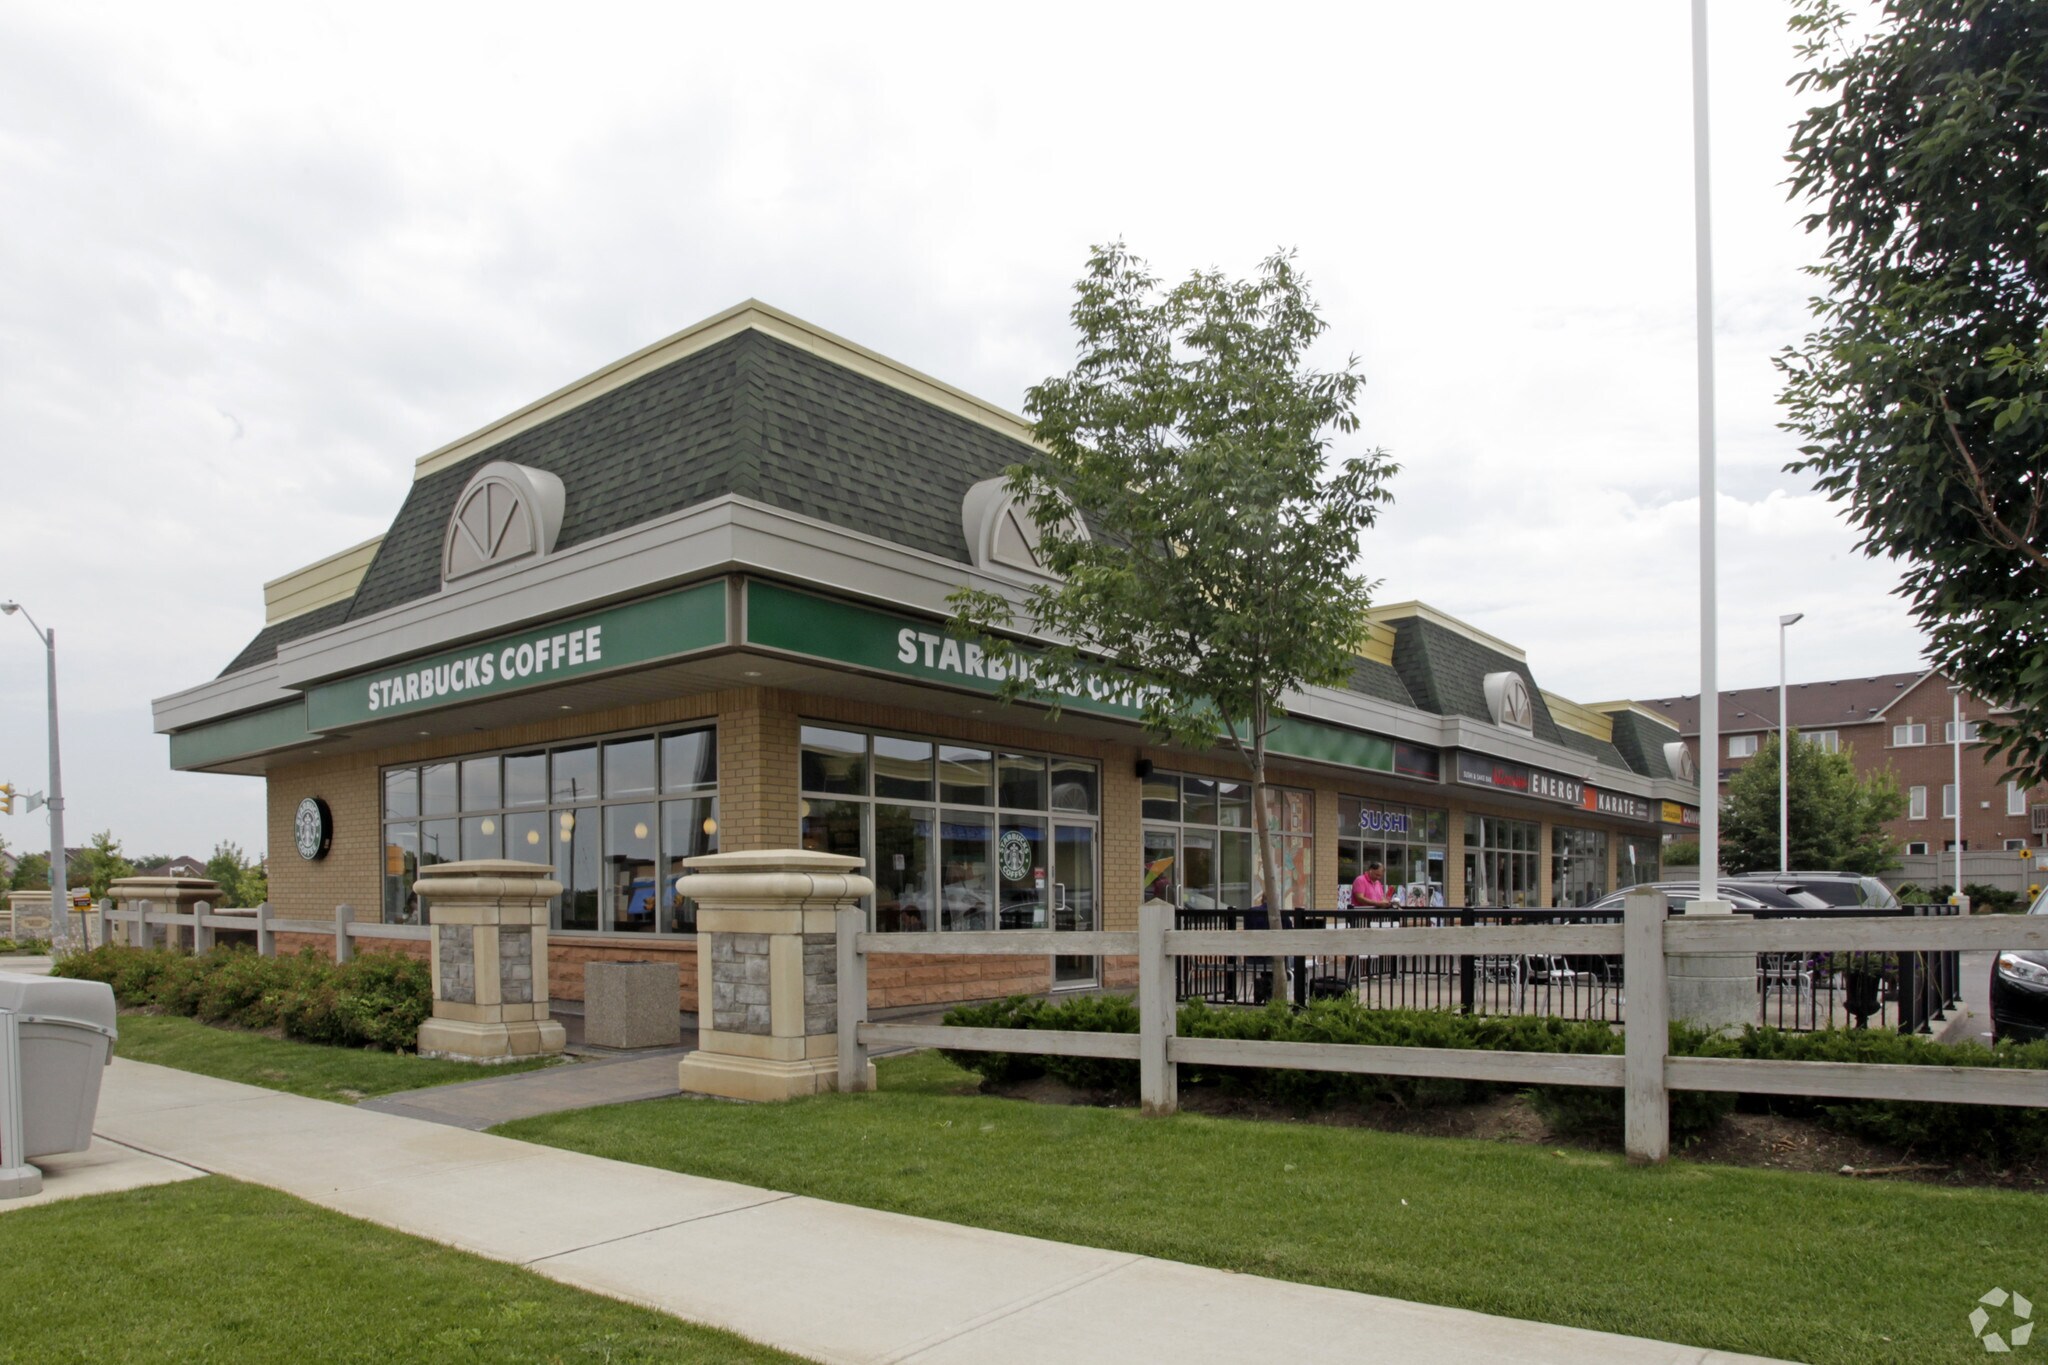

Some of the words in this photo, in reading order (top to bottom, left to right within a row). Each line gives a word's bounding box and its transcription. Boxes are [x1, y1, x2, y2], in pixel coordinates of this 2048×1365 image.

[368, 652, 495, 711] STARBUCKS
[499, 625, 602, 681] COFFEE
[1532, 774, 1581, 802] ENERGY
[1598, 793, 1635, 816] KARATE
[1359, 808, 1408, 833] SUSHI
[1000, 833, 1029, 854] STARBUCKS
[1002, 865, 1026, 878] COFFEE
